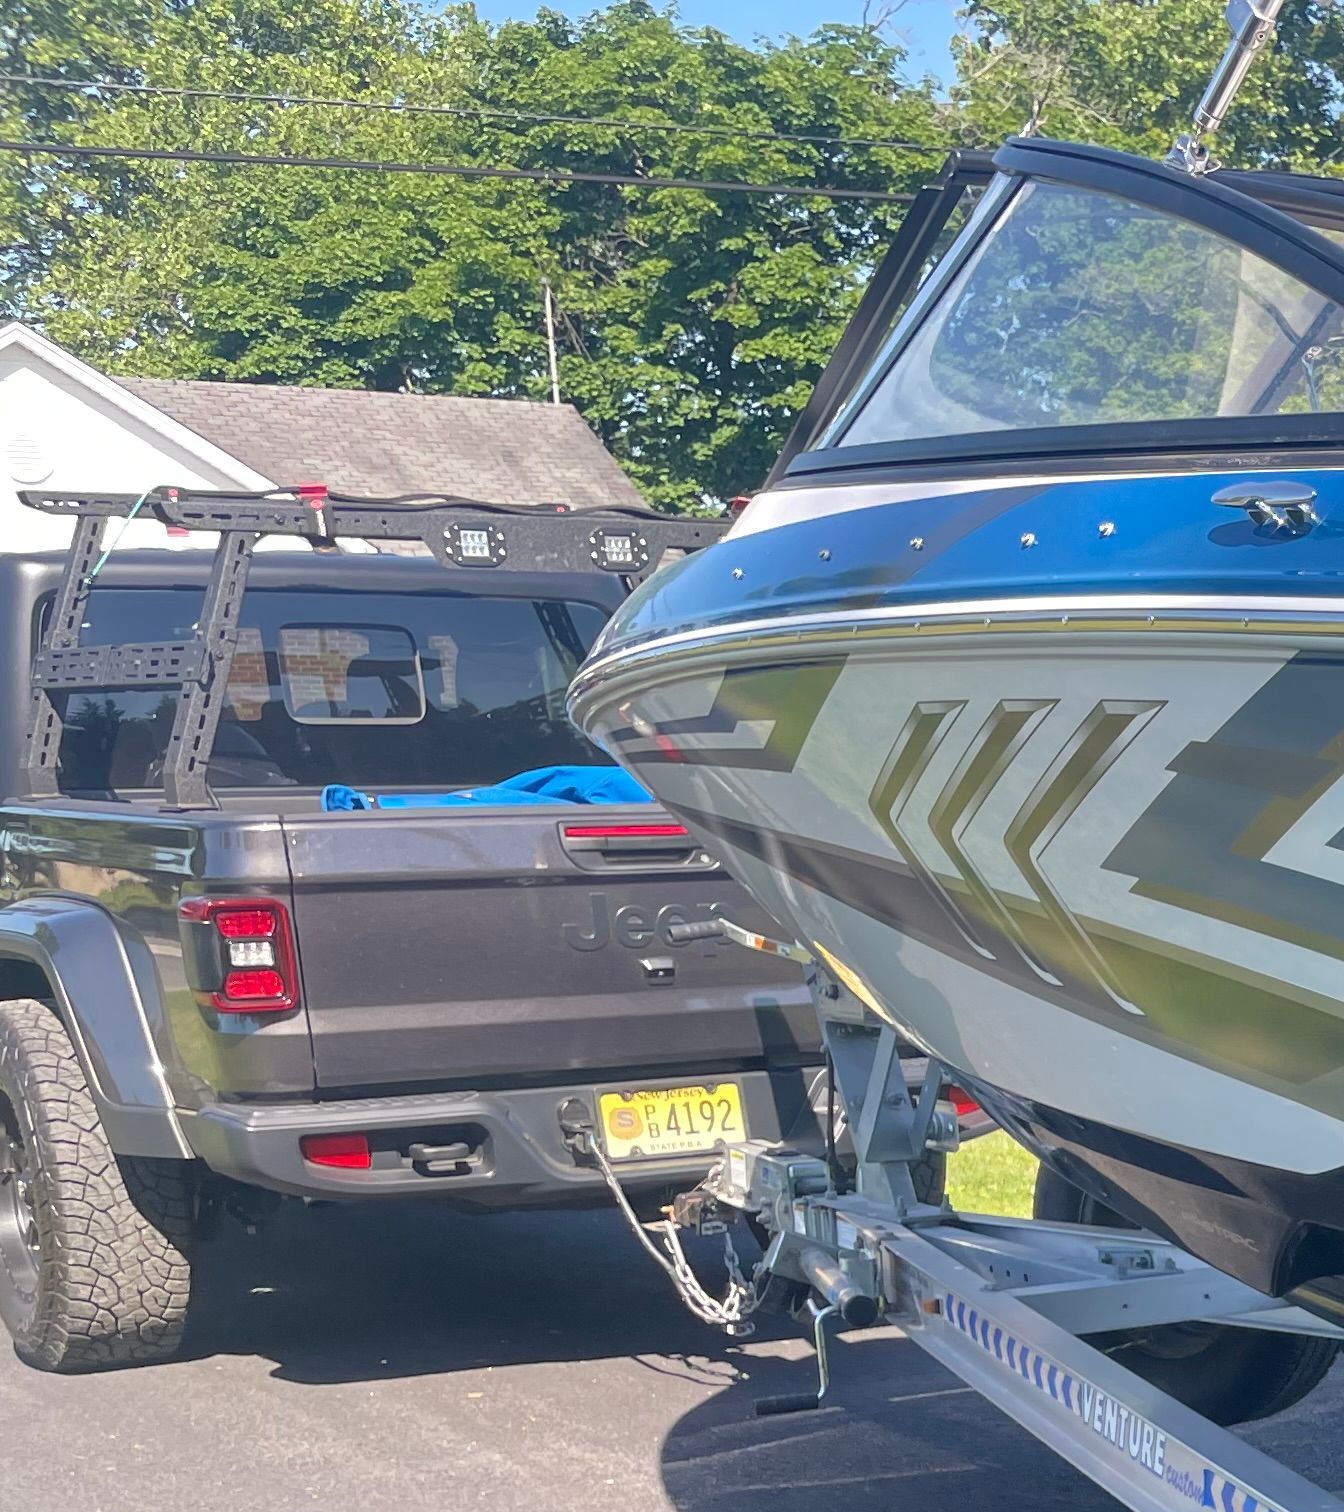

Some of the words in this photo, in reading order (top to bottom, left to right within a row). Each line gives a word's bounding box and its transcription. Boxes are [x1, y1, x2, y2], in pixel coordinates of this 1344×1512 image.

[664, 1087, 704, 1103] Jersey
[666, 1099, 736, 1136] 4192
[1081, 1382, 1166, 1477] VENTURE
